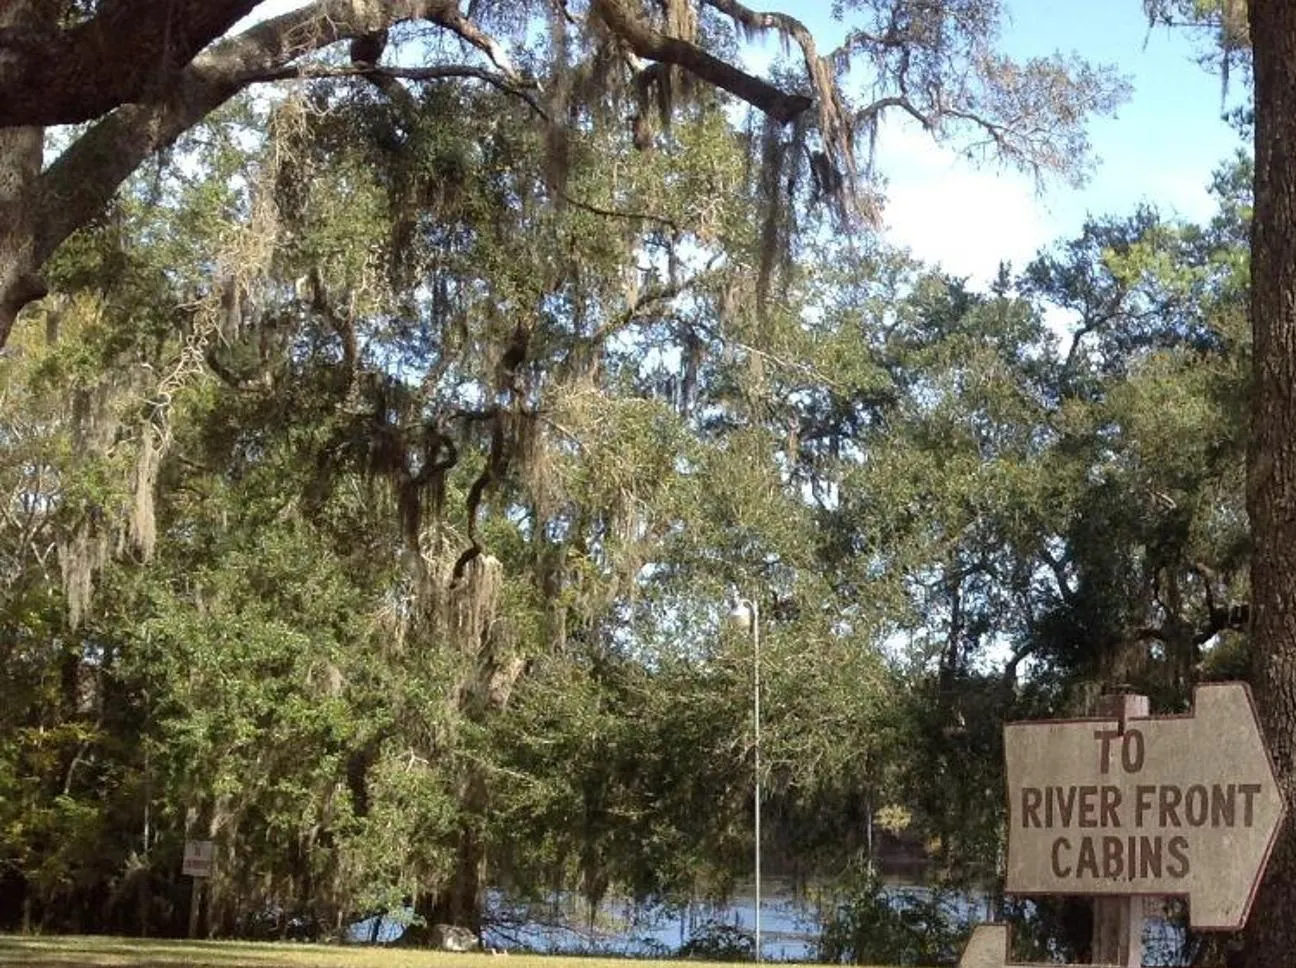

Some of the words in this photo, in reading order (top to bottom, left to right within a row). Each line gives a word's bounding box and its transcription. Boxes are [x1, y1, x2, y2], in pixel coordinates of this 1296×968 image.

[1094, 728, 1145, 775] TO
[1022, 785, 1122, 828] RIVER
[1135, 783, 1261, 828] FRONT
[1051, 836, 1190, 879] CABINS
